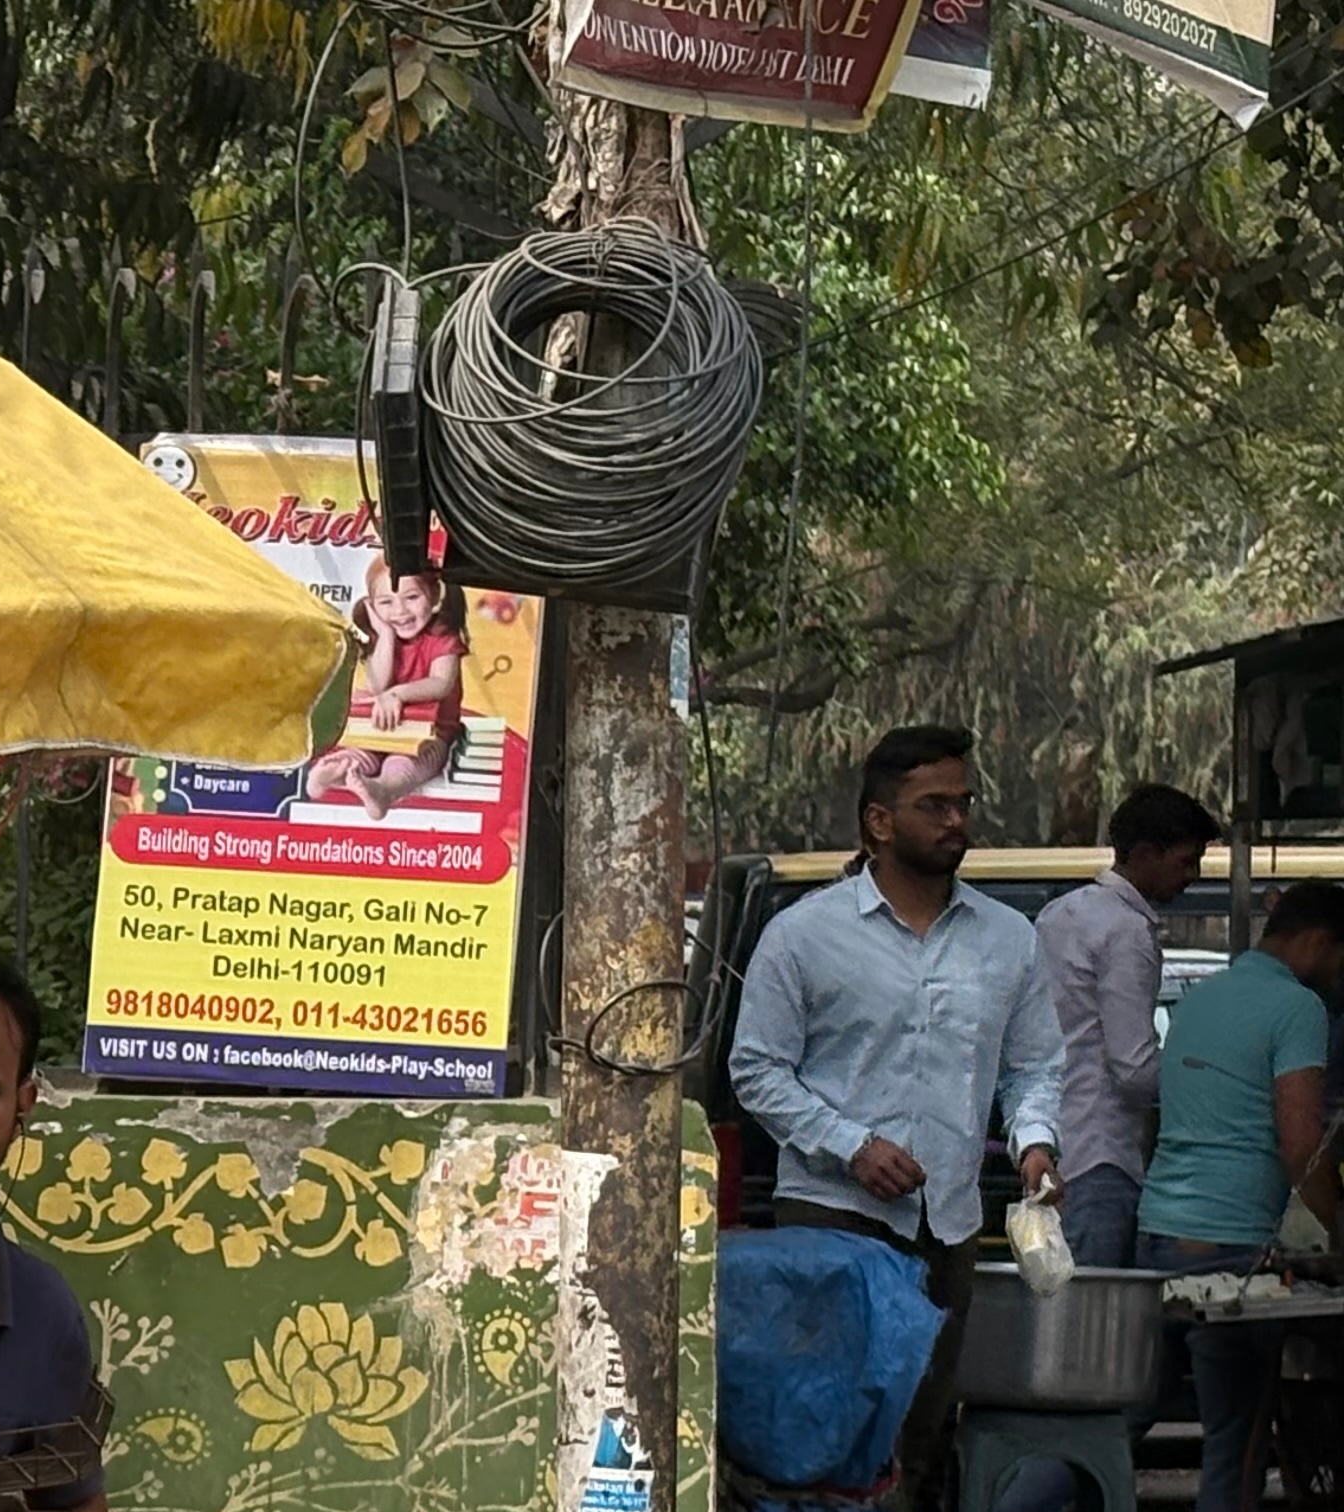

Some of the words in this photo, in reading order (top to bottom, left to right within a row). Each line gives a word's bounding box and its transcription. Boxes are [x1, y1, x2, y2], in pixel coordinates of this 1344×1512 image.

[193, 774, 250, 794] Daycare
[137, 827, 210, 861] Building
[214, 832, 273, 865] Strong
[276, 834, 385, 867] Foundations
[123, 884, 163, 911] 50,
[172, 887, 260, 916] Pratap
[268, 892, 355, 923] Nagar,
[363, 898, 416, 924] Gali
[424, 901, 489, 926] No-7
[119, 917, 194, 942] Near-
[201, 922, 281, 949] Laxmi
[289, 926, 385, 957] Naryan
[393, 934, 488, 960] Mandir
[212, 955, 386, 987] Delhi-110091
[105, 989, 282, 1030] 9818040902,
[292, 1001, 488, 1037] 011-43021656
[99, 1037, 148, 1061] VISIT
[151, 1041, 178, 1062] US
[182, 1042, 208, 1063] ON
